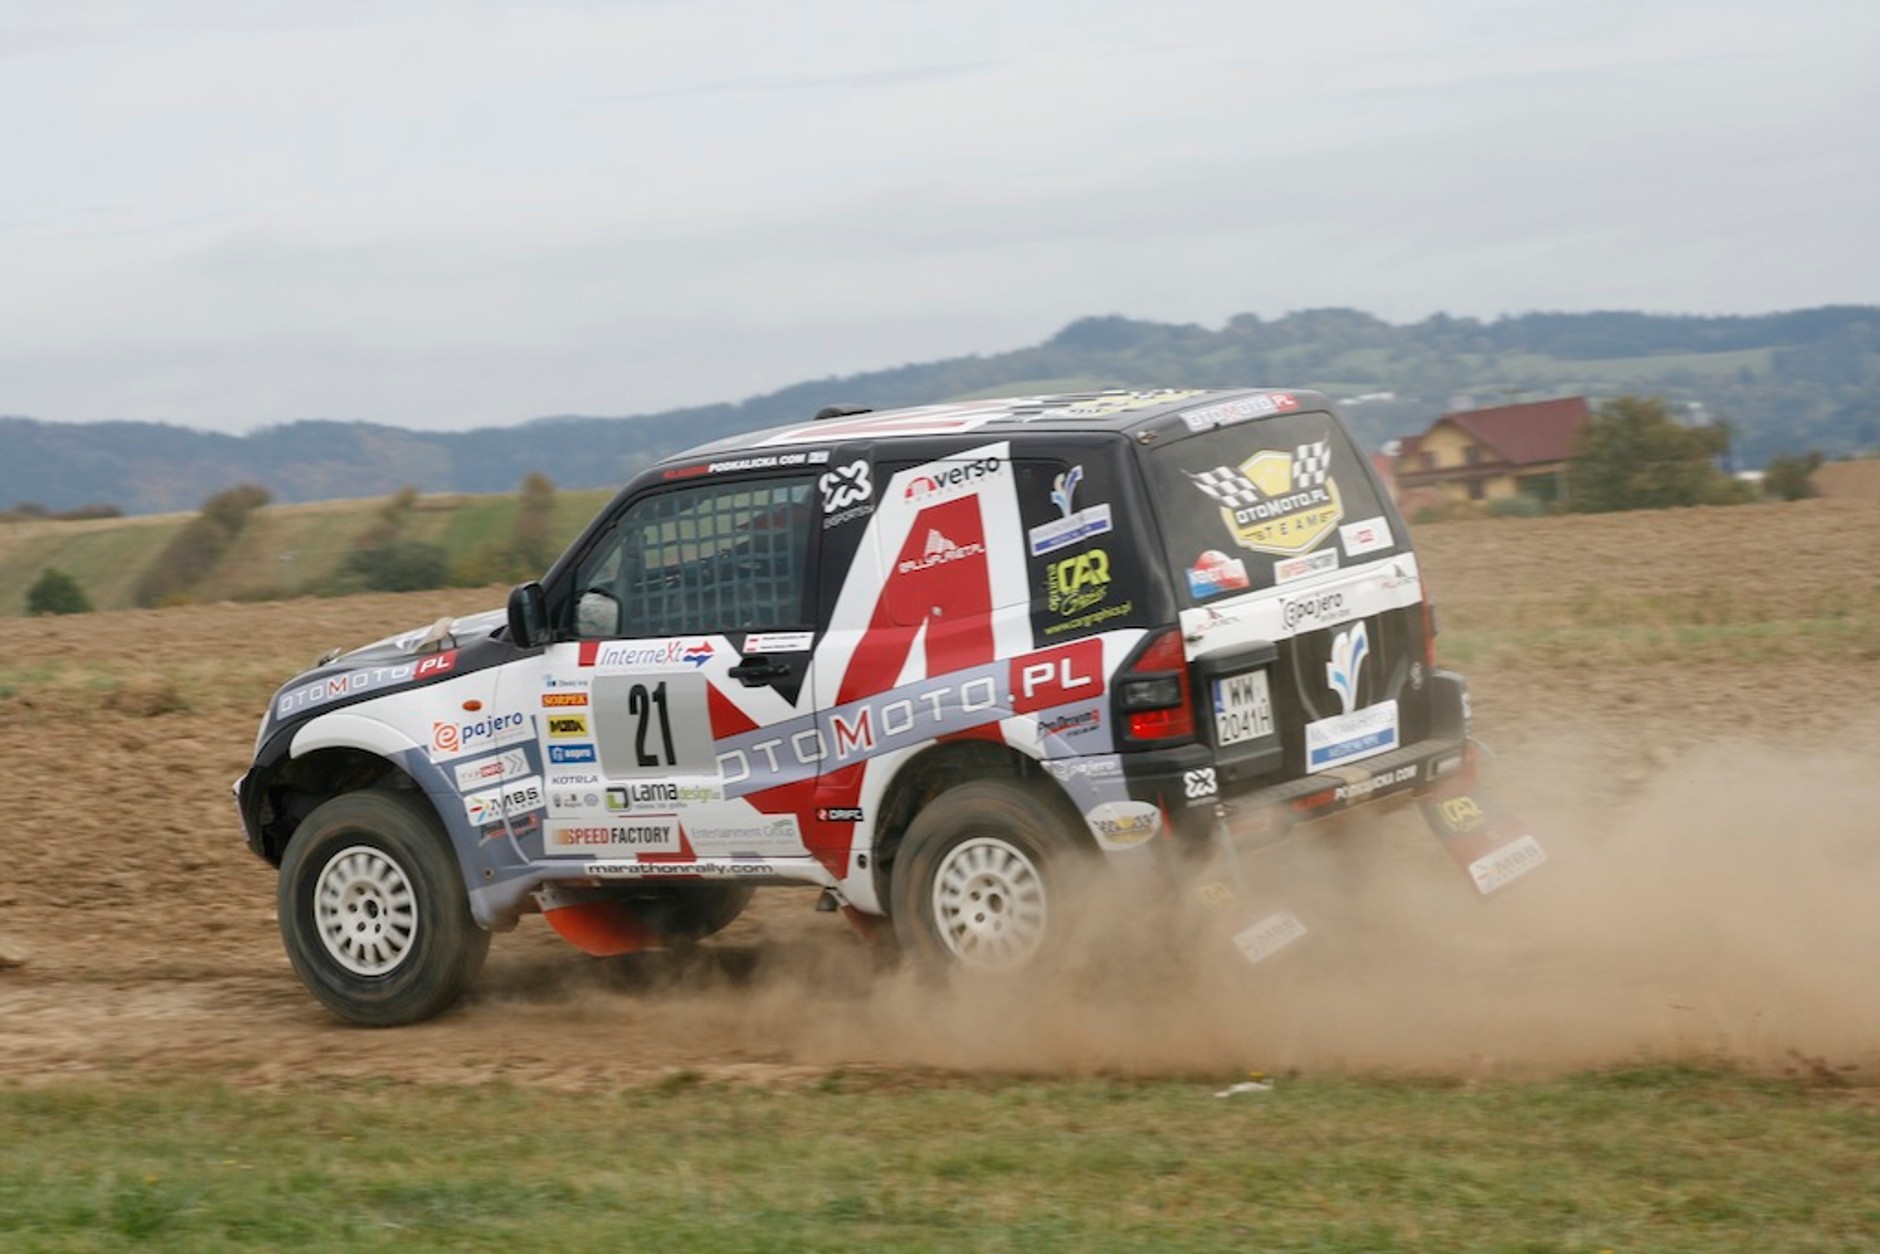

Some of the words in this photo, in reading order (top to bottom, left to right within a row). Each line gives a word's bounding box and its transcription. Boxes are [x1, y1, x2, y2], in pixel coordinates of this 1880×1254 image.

[1236, 488, 1330, 524] OTOMOTO.PL
[280, 656, 451, 712] OTOMOTO.PL
[1228, 676, 1255, 707] WW
[628, 681, 677, 768] 21
[715, 657, 1092, 785] OTOMOTO.PL
[1219, 704, 1273, 742] 2041H
[552, 775, 599, 786] KOTRLA
[491, 787, 539, 811] MBS
[588, 862, 774, 876] marathonrally.com
